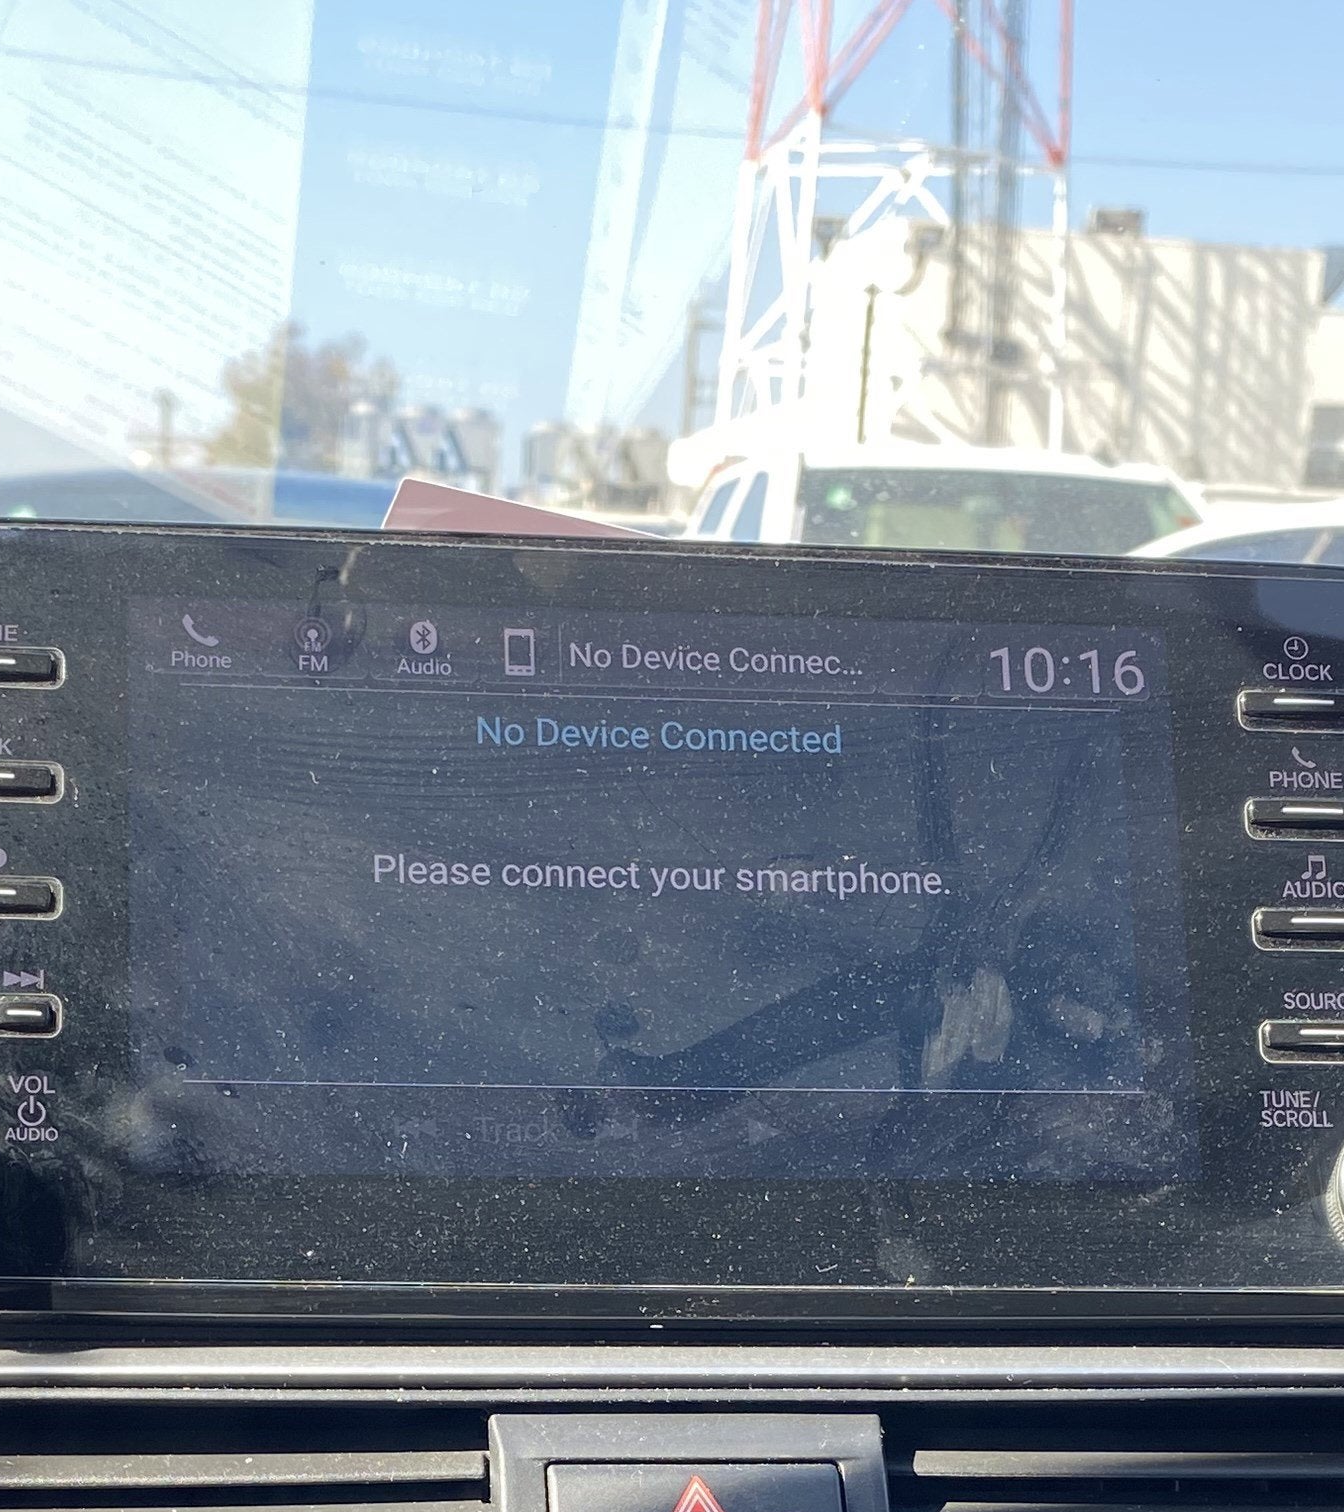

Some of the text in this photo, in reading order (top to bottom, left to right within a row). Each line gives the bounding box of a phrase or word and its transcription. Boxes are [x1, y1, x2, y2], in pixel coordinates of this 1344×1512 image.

[170, 650, 233, 669] Phone
[298, 655, 329, 672] FM
[396, 657, 453, 676] Audio
[569, 642, 863, 676] No Device Connec...
[990, 646, 1146, 696] 10:16
[1262, 663, 1334, 683] CLOCK
[476, 716, 843, 755] No Device Connected
[1269, 770, 1344, 790] PHONE
[373, 854, 953, 901] Please connect your smartphone.
[8, 1074, 56, 1095] VOL
[1260, 1090, 1321, 1109] TUNE/
[1260, 1110, 1334, 1129] SCROLL
[4, 1126, 59, 1143] AUDIO
